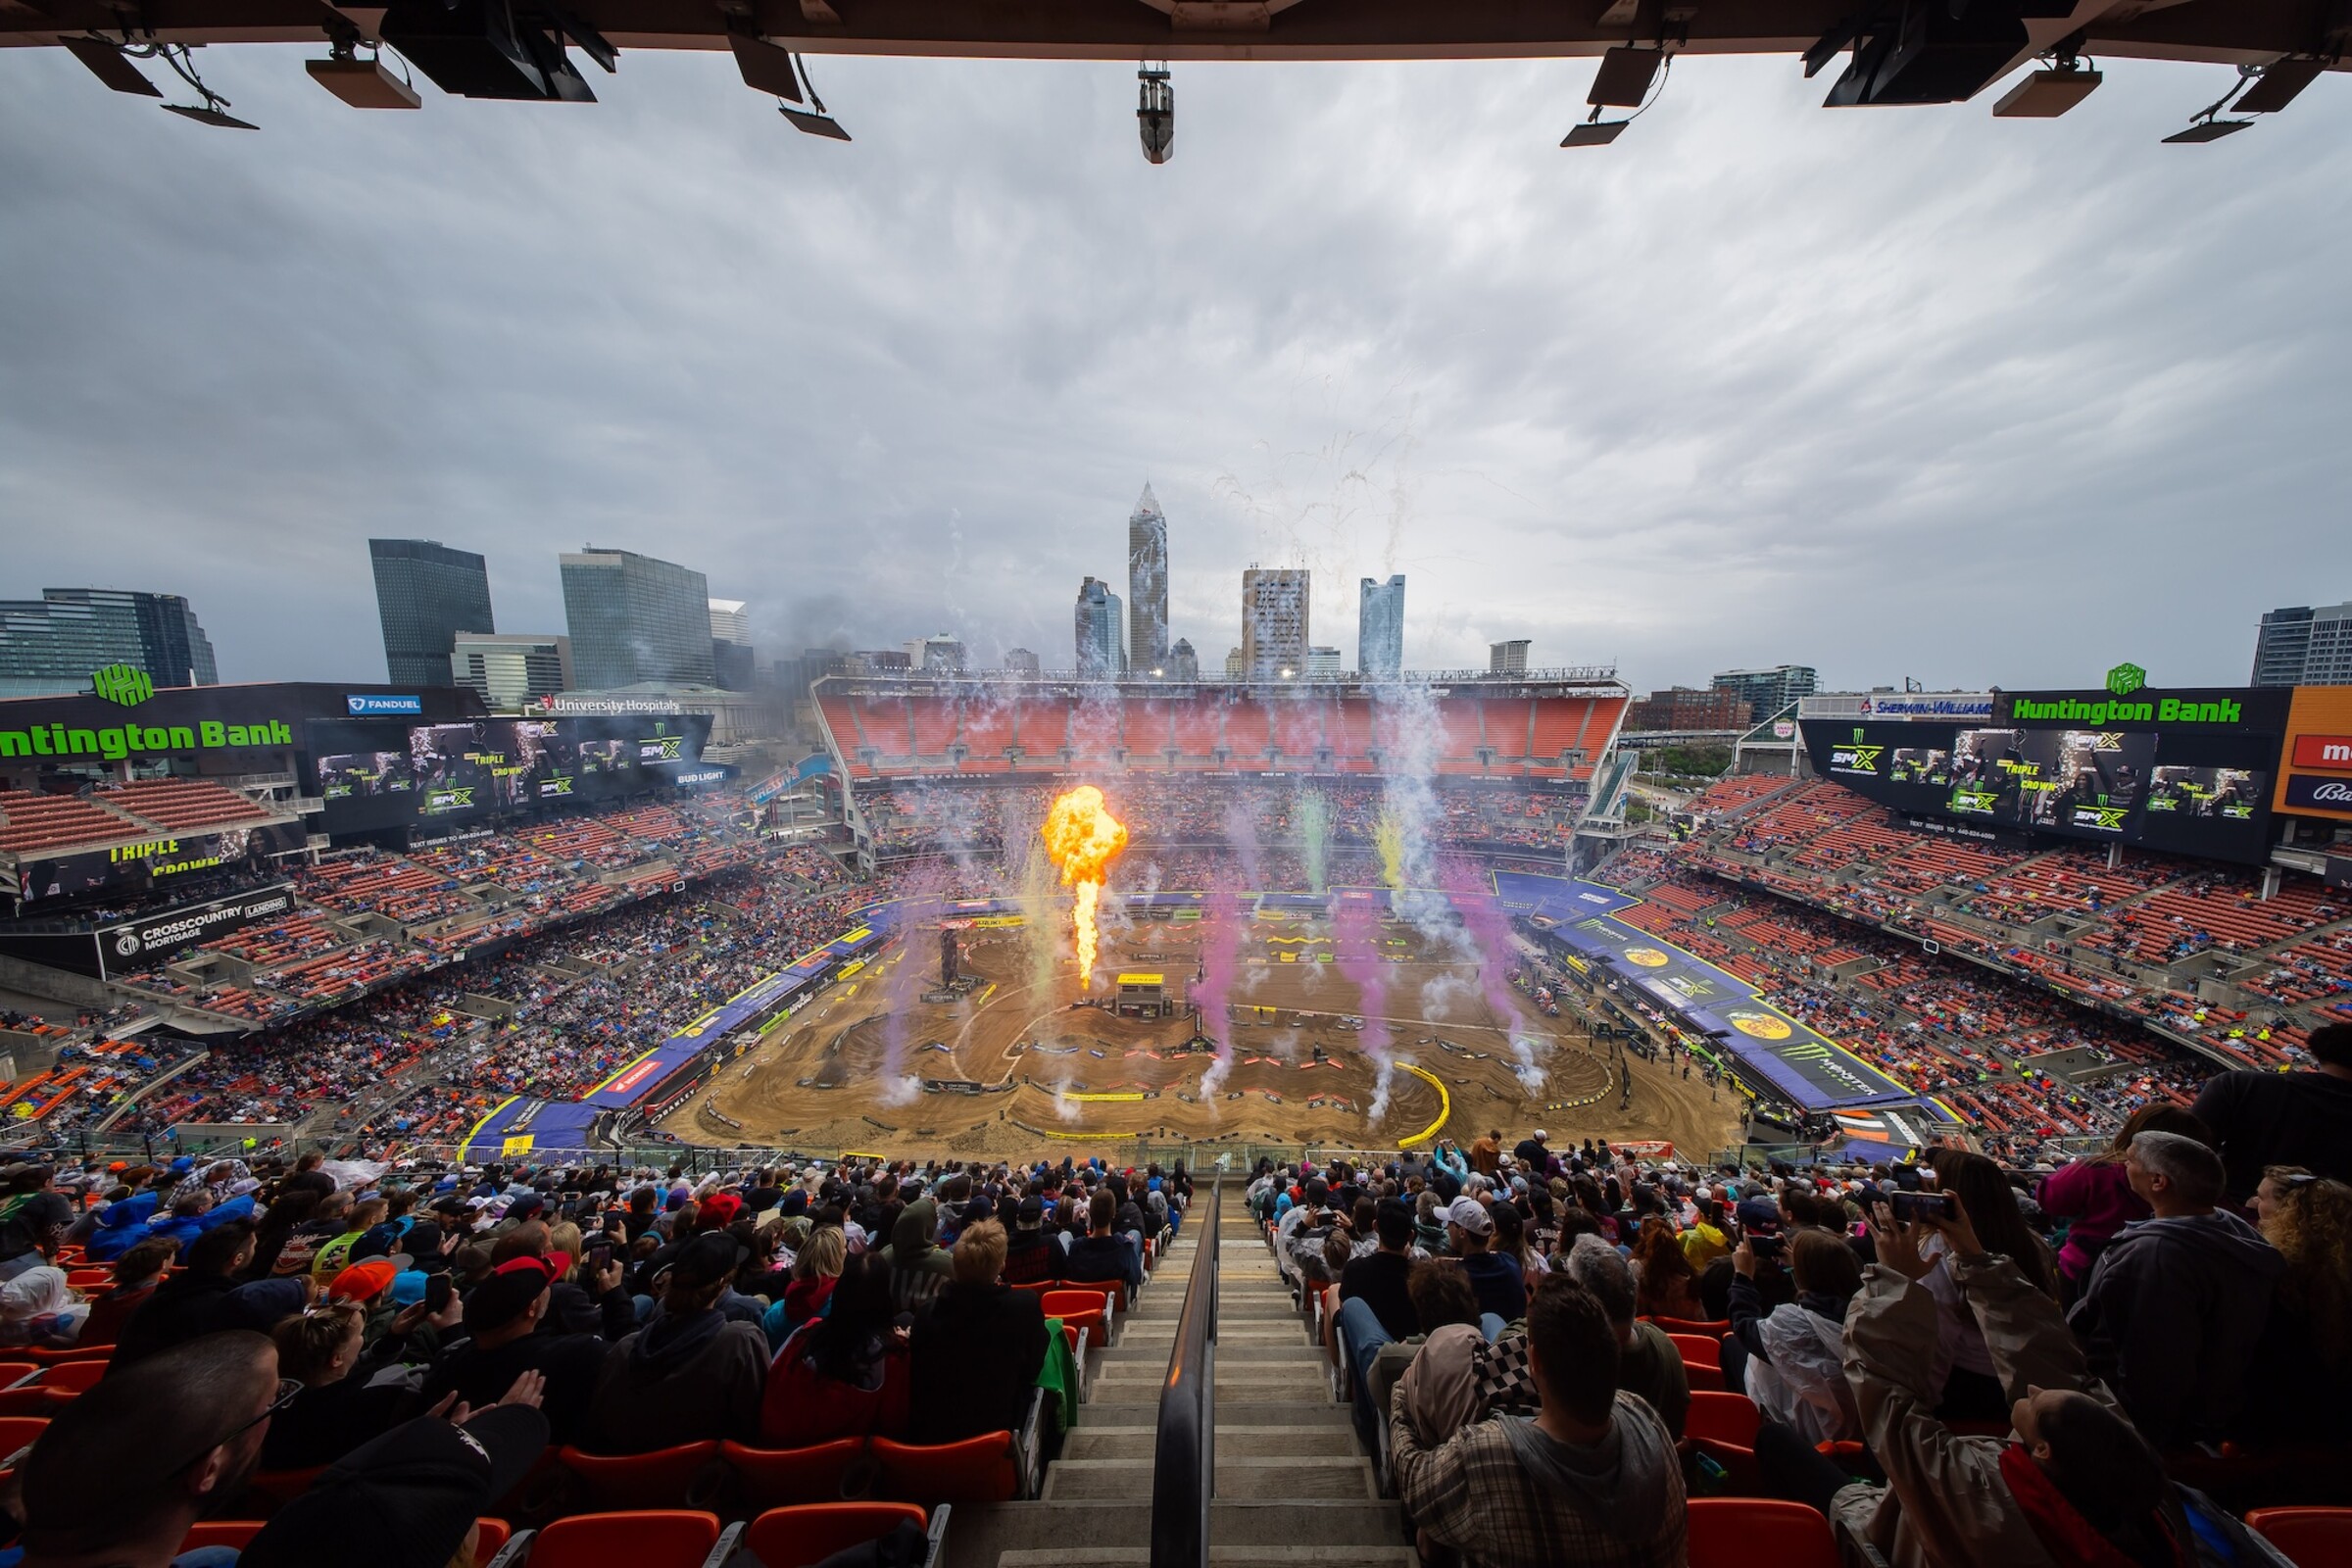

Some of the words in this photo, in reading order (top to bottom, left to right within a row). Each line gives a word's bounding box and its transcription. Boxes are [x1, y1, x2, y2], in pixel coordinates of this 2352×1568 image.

[368, 700, 420, 710] FANDUEL
[555, 699, 624, 713] University
[625, 699, 678, 713] Hospitals
[2013, 698, 2153, 725] Huntington
[2158, 698, 2241, 722] Bank
[199, 718, 292, 748] Bank
[641, 741, 681, 759] SMX
[2323, 745, 2352, 760] m
[474, 755, 505, 765] TRIPLE
[1831, 751, 1882, 770] SMX
[492, 767, 522, 776] CROWN
[2006, 763, 2039, 775] TRIPLE
[678, 773, 698, 784] BUD
[699, 771, 724, 782] LIGHT
[2021, 780, 2056, 791] CROWN
[541, 780, 571, 794] SMX
[432, 790, 472, 806] SMX
[1958, 793, 1996, 810] SMX
[2074, 810, 2128, 828] SMX
[1926, 823, 1944, 832] ISSUES
[111, 838, 179, 863] TRIPLE
[410, 840, 425, 849] TEXT
[426, 837, 447, 847] ISSUES
[142, 905, 243, 941] CROSSCOUNTRY
[247, 899, 284, 916] LANDING
[144, 928, 202, 952] MORTGAGE
[624, 1061, 657, 1086] HONDA
[1820, 1058, 1879, 1096] MONSTER
[662, 1088, 696, 1115] OAKLEY
